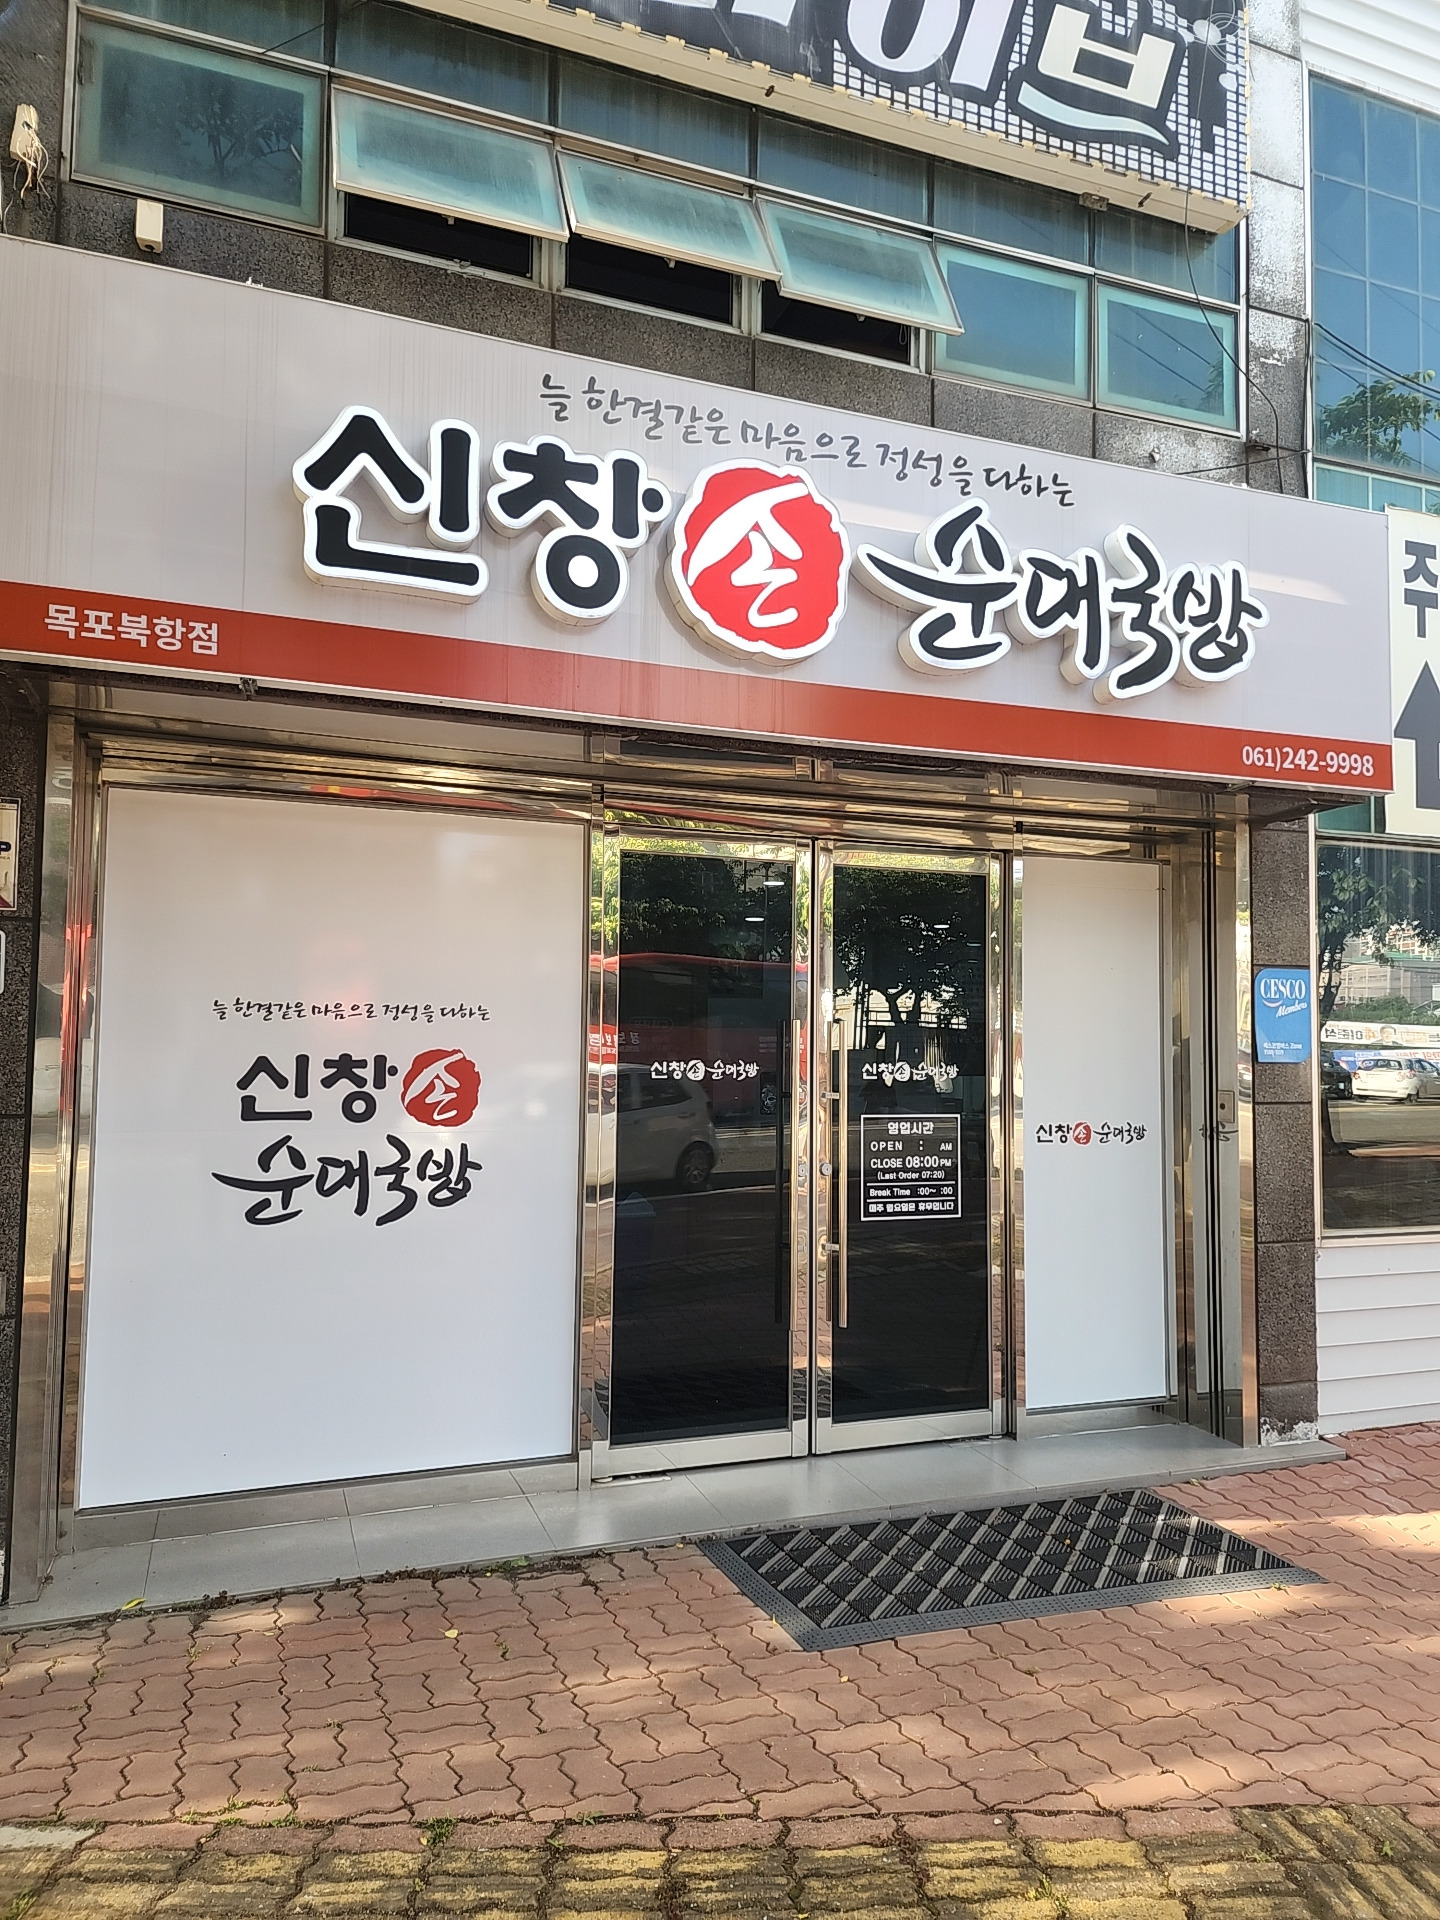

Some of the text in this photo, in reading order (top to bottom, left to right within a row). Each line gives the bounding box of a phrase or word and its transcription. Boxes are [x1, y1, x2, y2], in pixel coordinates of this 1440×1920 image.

[540, 374, 1074, 507] 늘 한결같은 마음으로 정성을 다하는
[44, 603, 218, 655] 목포북항점
[1241, 744, 1375, 777] 061)242-9998
[1260, 978, 1306, 1000] CESCO
[212, 997, 490, 1022] 늘 한결같은 마음으로 정성을 다하는
[1276, 1000, 1307, 1018] Members
[887, 1121, 934, 1135] 영업시간
[870, 1141, 903, 1151] OPEN
[940, 1142, 953, 1151] AM
[870, 1156, 952, 1168] CLOSE 08:00 PM
[211, 1134, 482, 1226] 순대국밥
[877, 1170, 945, 1180] (Last Order 07:20)
[870, 1188, 891, 1196] Break
[893, 1188, 911, 1196] Time
